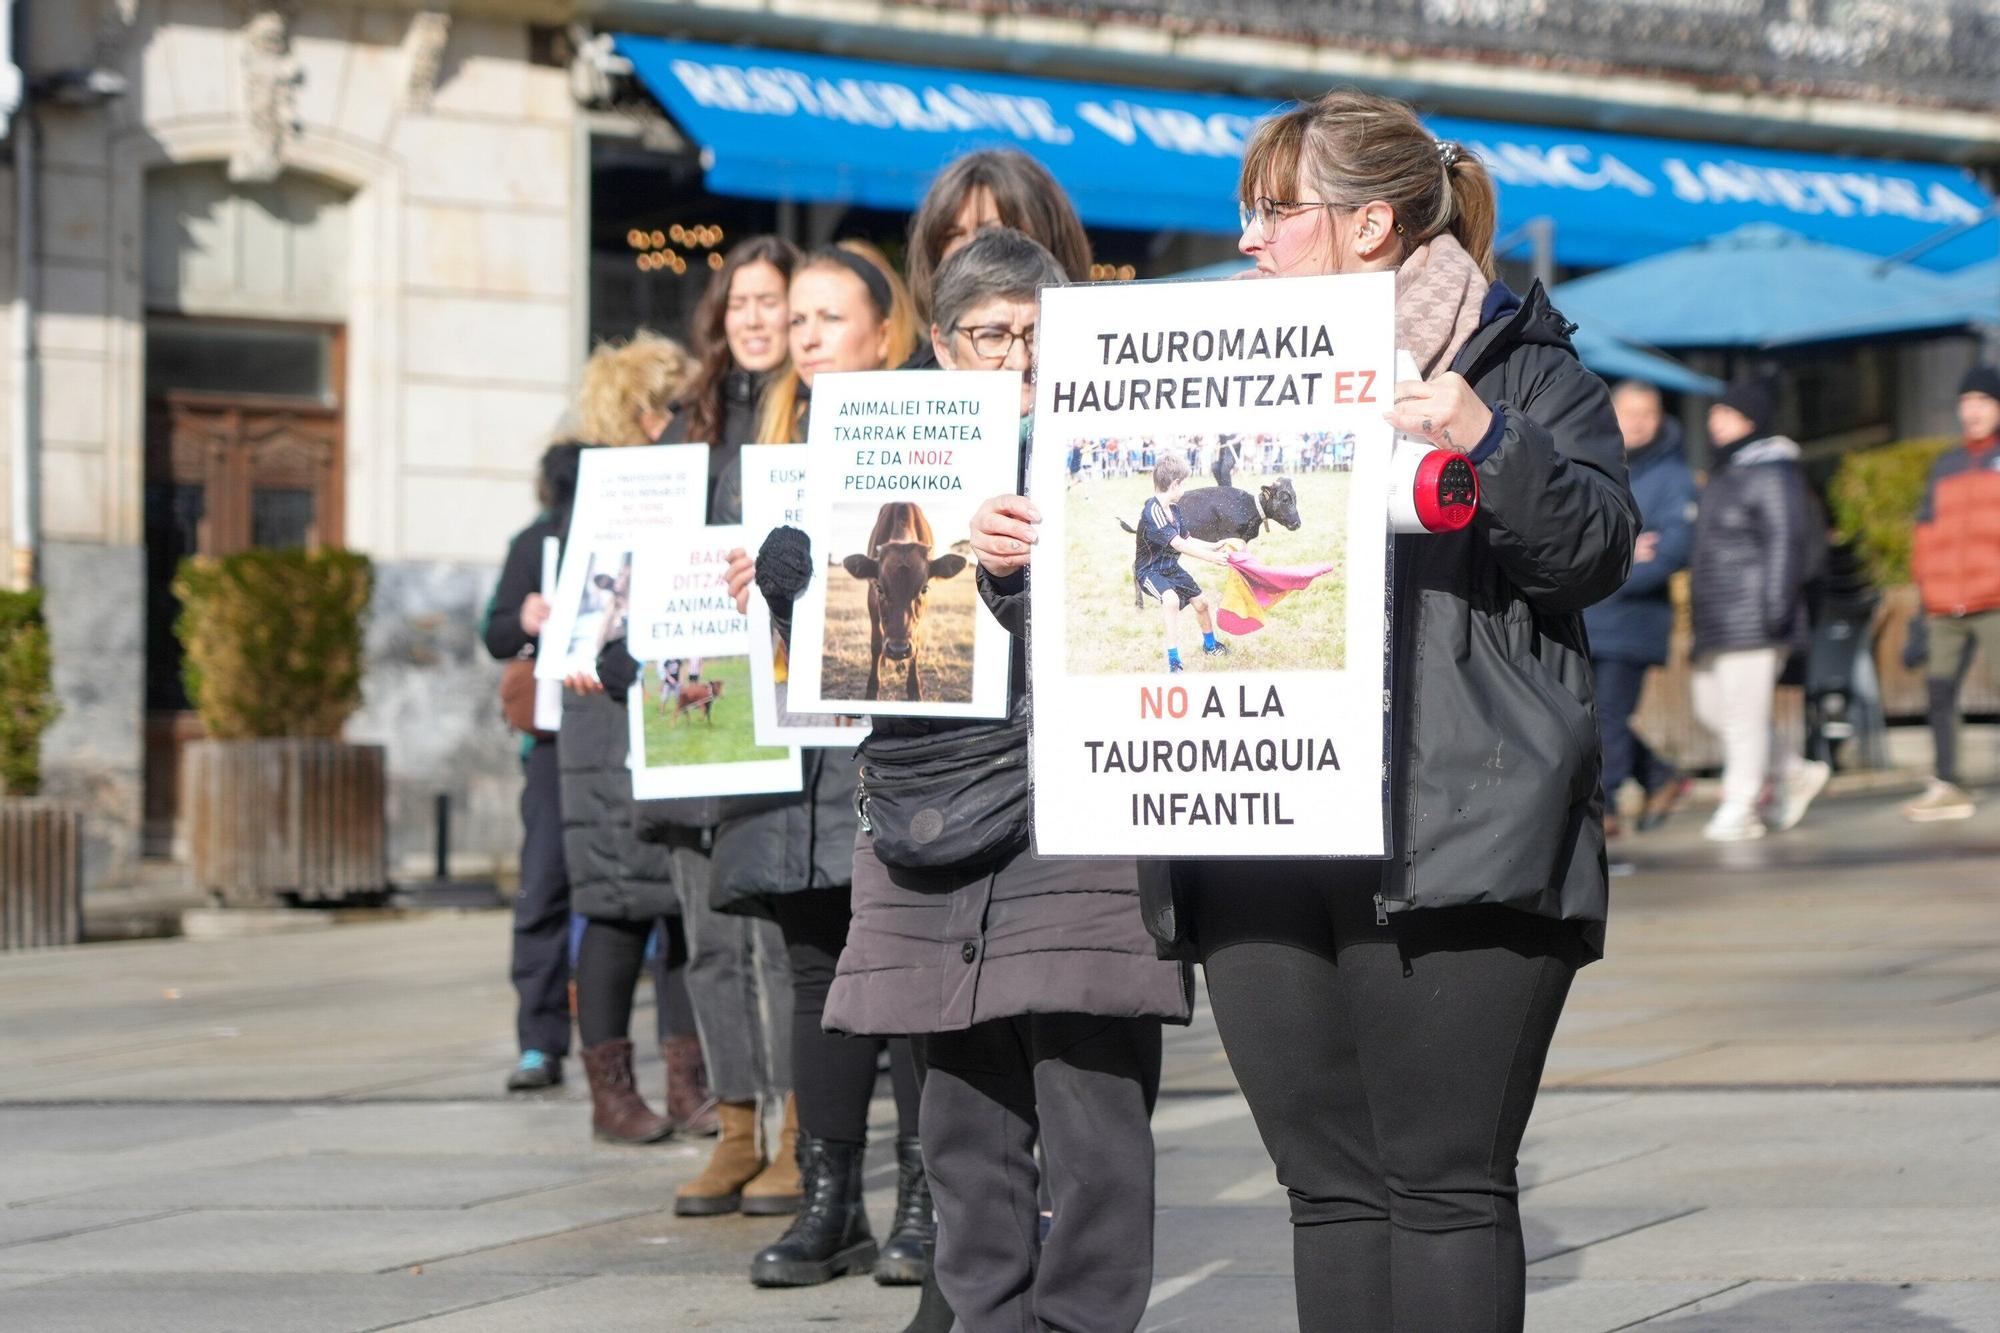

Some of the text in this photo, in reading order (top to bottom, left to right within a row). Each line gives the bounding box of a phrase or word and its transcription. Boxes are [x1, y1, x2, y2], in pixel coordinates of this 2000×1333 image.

[670, 58, 1075, 146] RESTAURANTE
[1097, 325, 1335, 365] TAUROMAKIA
[839, 400, 980, 416] ANIMALIEI TRATU
[1052, 370, 1377, 413] HAURRENTZAT EZ
[834, 426, 982, 441] TXARRAK EMATEA
[856, 450, 953, 465] EZ DA INOIZ
[844, 475, 962, 490] PEDAGOKIKOA
[652, 622, 684, 638] ETA
[1140, 685, 1285, 719] NO A LA
[1084, 739, 1341, 773] TAUROMAQUIA
[1132, 793, 1294, 826] INFANTIL
